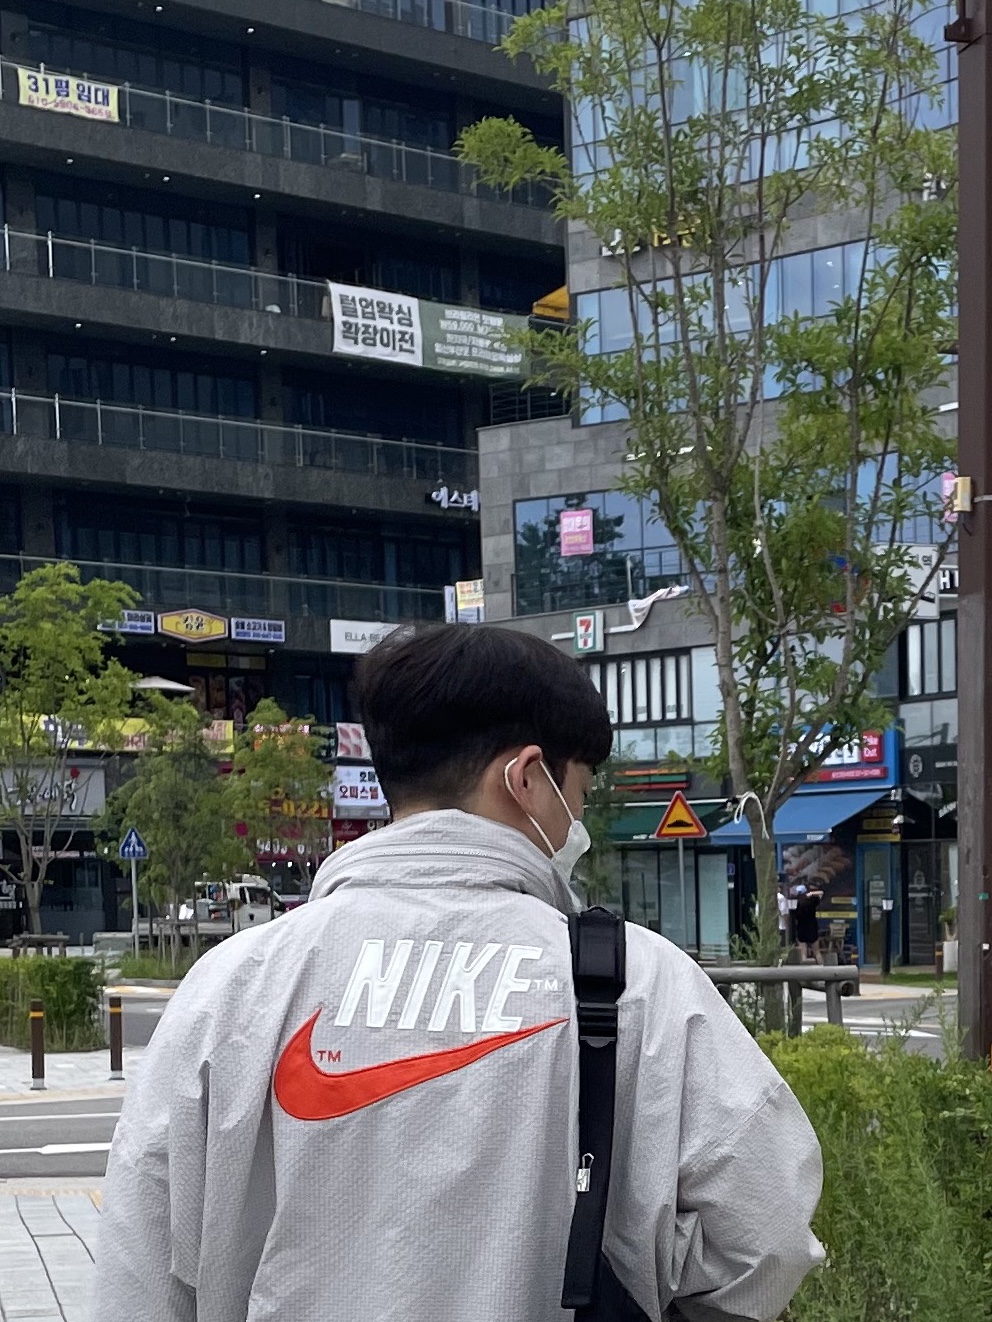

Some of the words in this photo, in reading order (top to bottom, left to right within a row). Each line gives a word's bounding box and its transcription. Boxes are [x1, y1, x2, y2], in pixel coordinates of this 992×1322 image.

[27, 74, 69, 97] 31평
[76, 82, 110, 107] 임대
[339, 294, 414, 328] 털업왁싱
[341, 319, 416, 355] 확장이전
[345, 631, 367, 642] ELLA
[334, 939, 544, 1033] NIKE
[317, 1050, 342, 1063] TM
